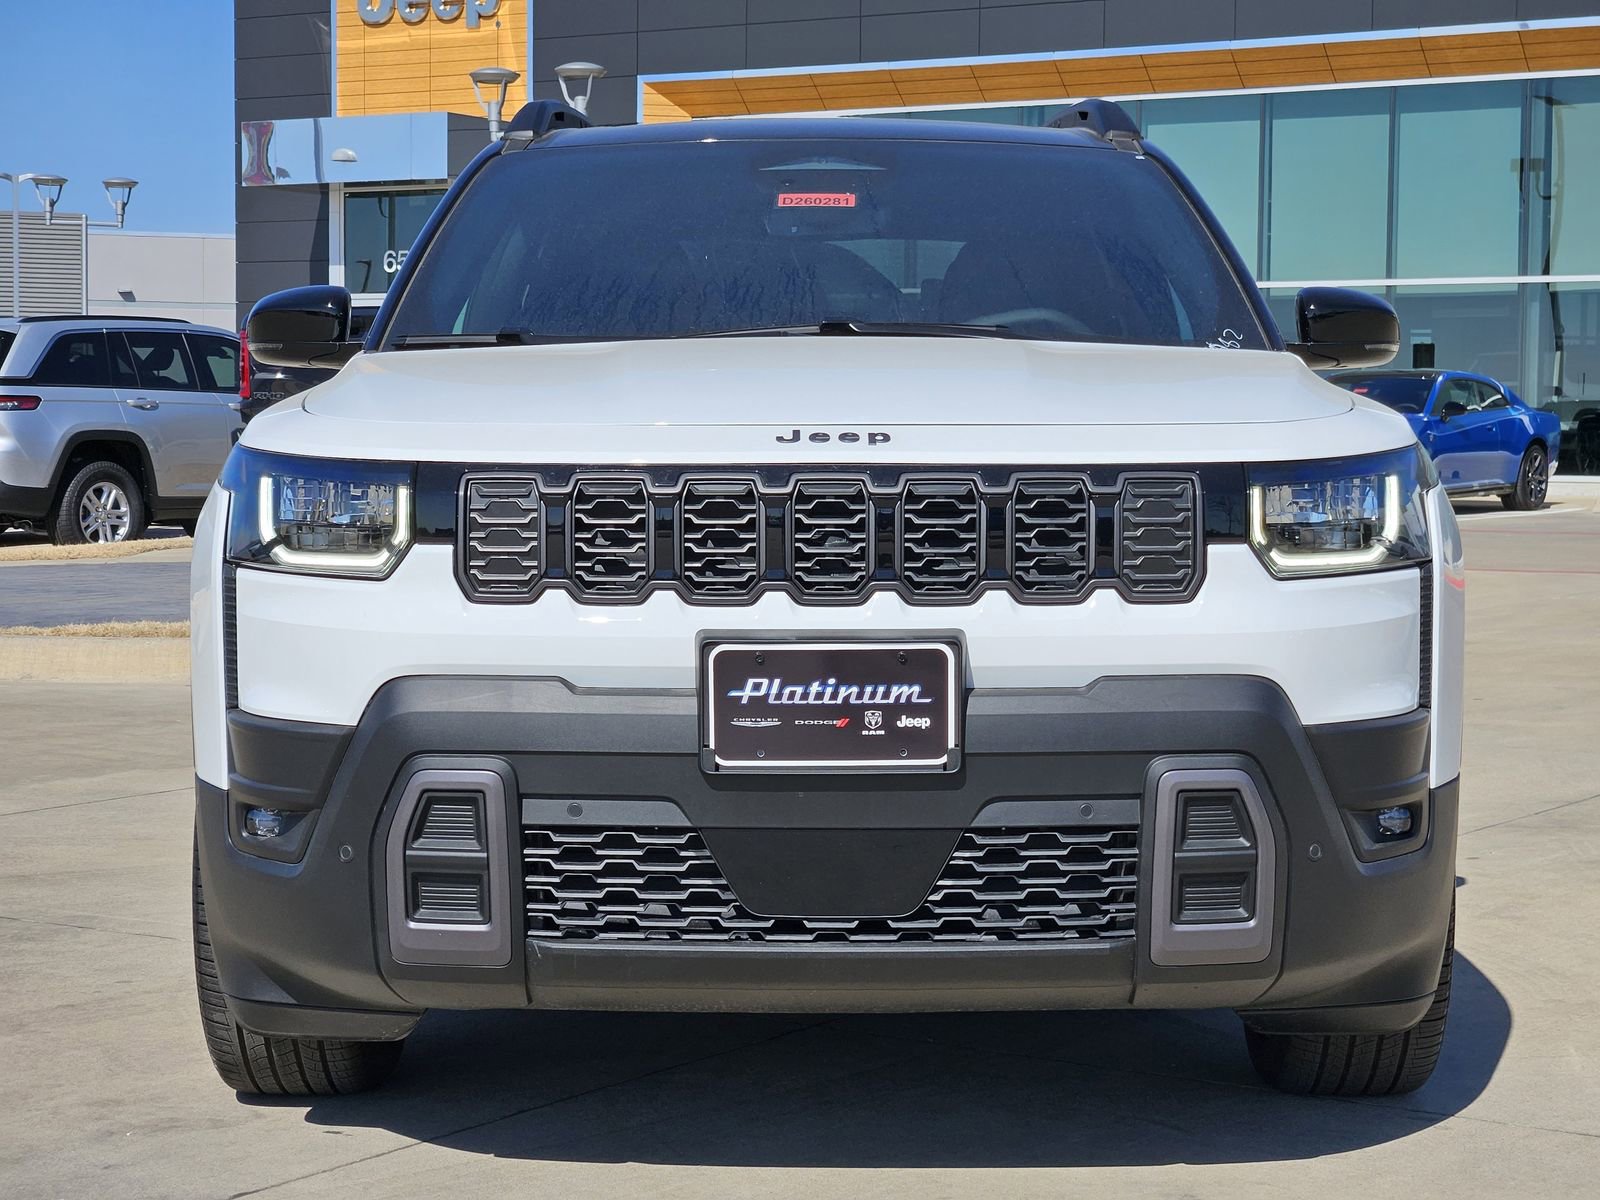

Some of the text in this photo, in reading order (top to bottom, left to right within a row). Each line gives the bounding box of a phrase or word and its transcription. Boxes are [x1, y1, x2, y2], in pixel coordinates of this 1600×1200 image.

[782, 197, 850, 206] D260281
[775, 429, 891, 446] Jeep
[727, 677, 934, 705] Platinum
[896, 714, 931, 730] Jeep
